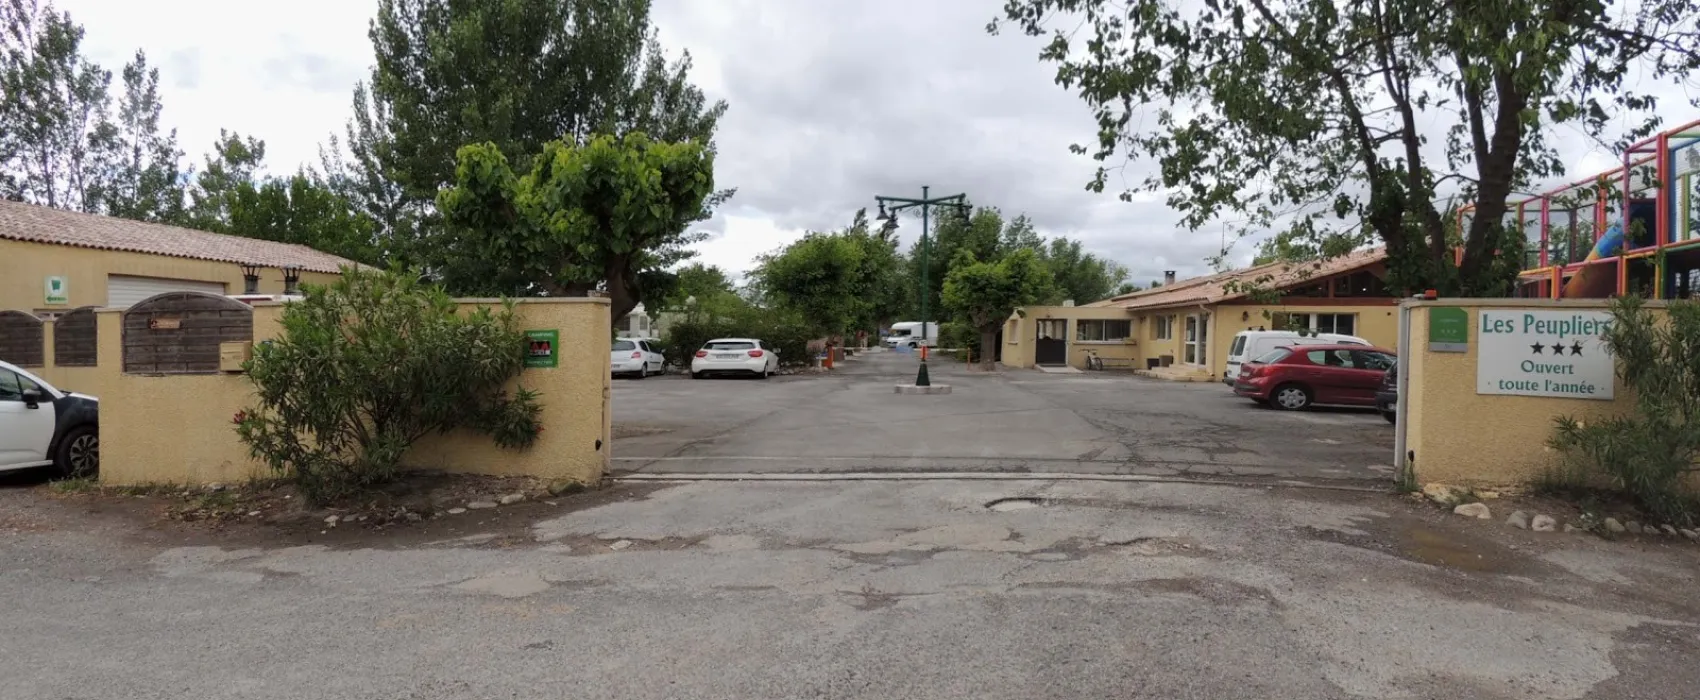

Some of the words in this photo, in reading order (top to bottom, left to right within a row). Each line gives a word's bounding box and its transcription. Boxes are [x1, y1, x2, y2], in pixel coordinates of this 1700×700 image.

[1482, 314, 1515, 334] Les
[1521, 360, 1575, 375] Ouvert
[1499, 380, 1539, 392] toute
[1545, 380, 1595, 394] l'année
